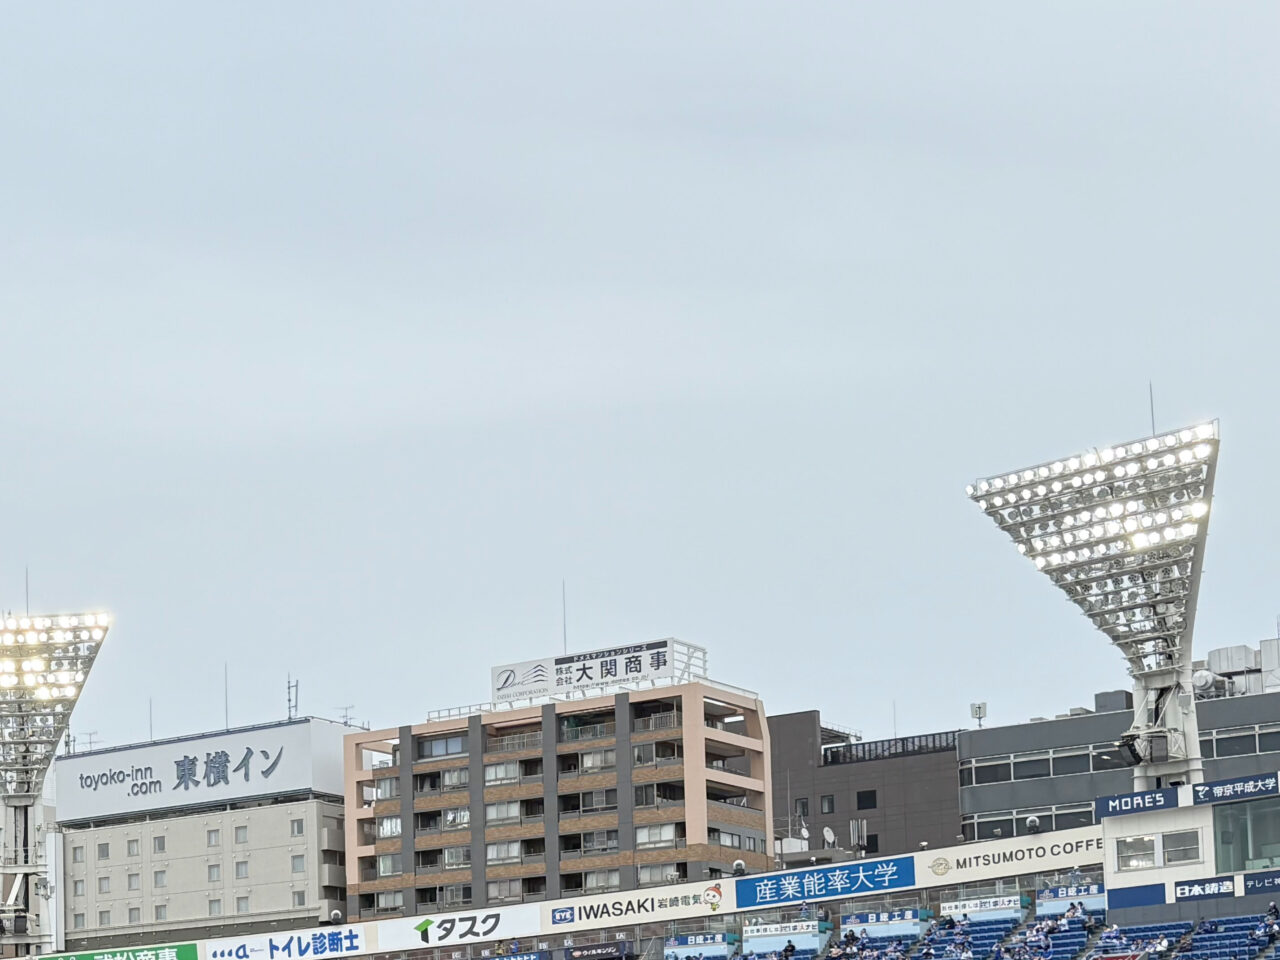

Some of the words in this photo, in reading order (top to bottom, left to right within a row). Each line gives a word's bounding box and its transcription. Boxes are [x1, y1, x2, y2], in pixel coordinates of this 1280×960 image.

[555, 665, 573, 676] 株式
[576, 651, 668, 683] 大関商事
[555, 676, 573, 687] 会社
[79, 766, 153, 791] toyoko-inn
[172, 746, 284, 791] 東横イン
[127, 779, 162, 797] .com
[1212, 777, 1277, 799] 帝京平成大学
[1108, 793, 1165, 812] MORE'S
[956, 845, 1046, 870] MITSUMOTO
[755, 862, 899, 903] 産業能率大学
[1176, 880, 1234, 898] 日本鋳造
[578, 897, 655, 921] IWASAKI
[436, 913, 501, 942] タスク
[269, 929, 360, 960] トイレ診断士
